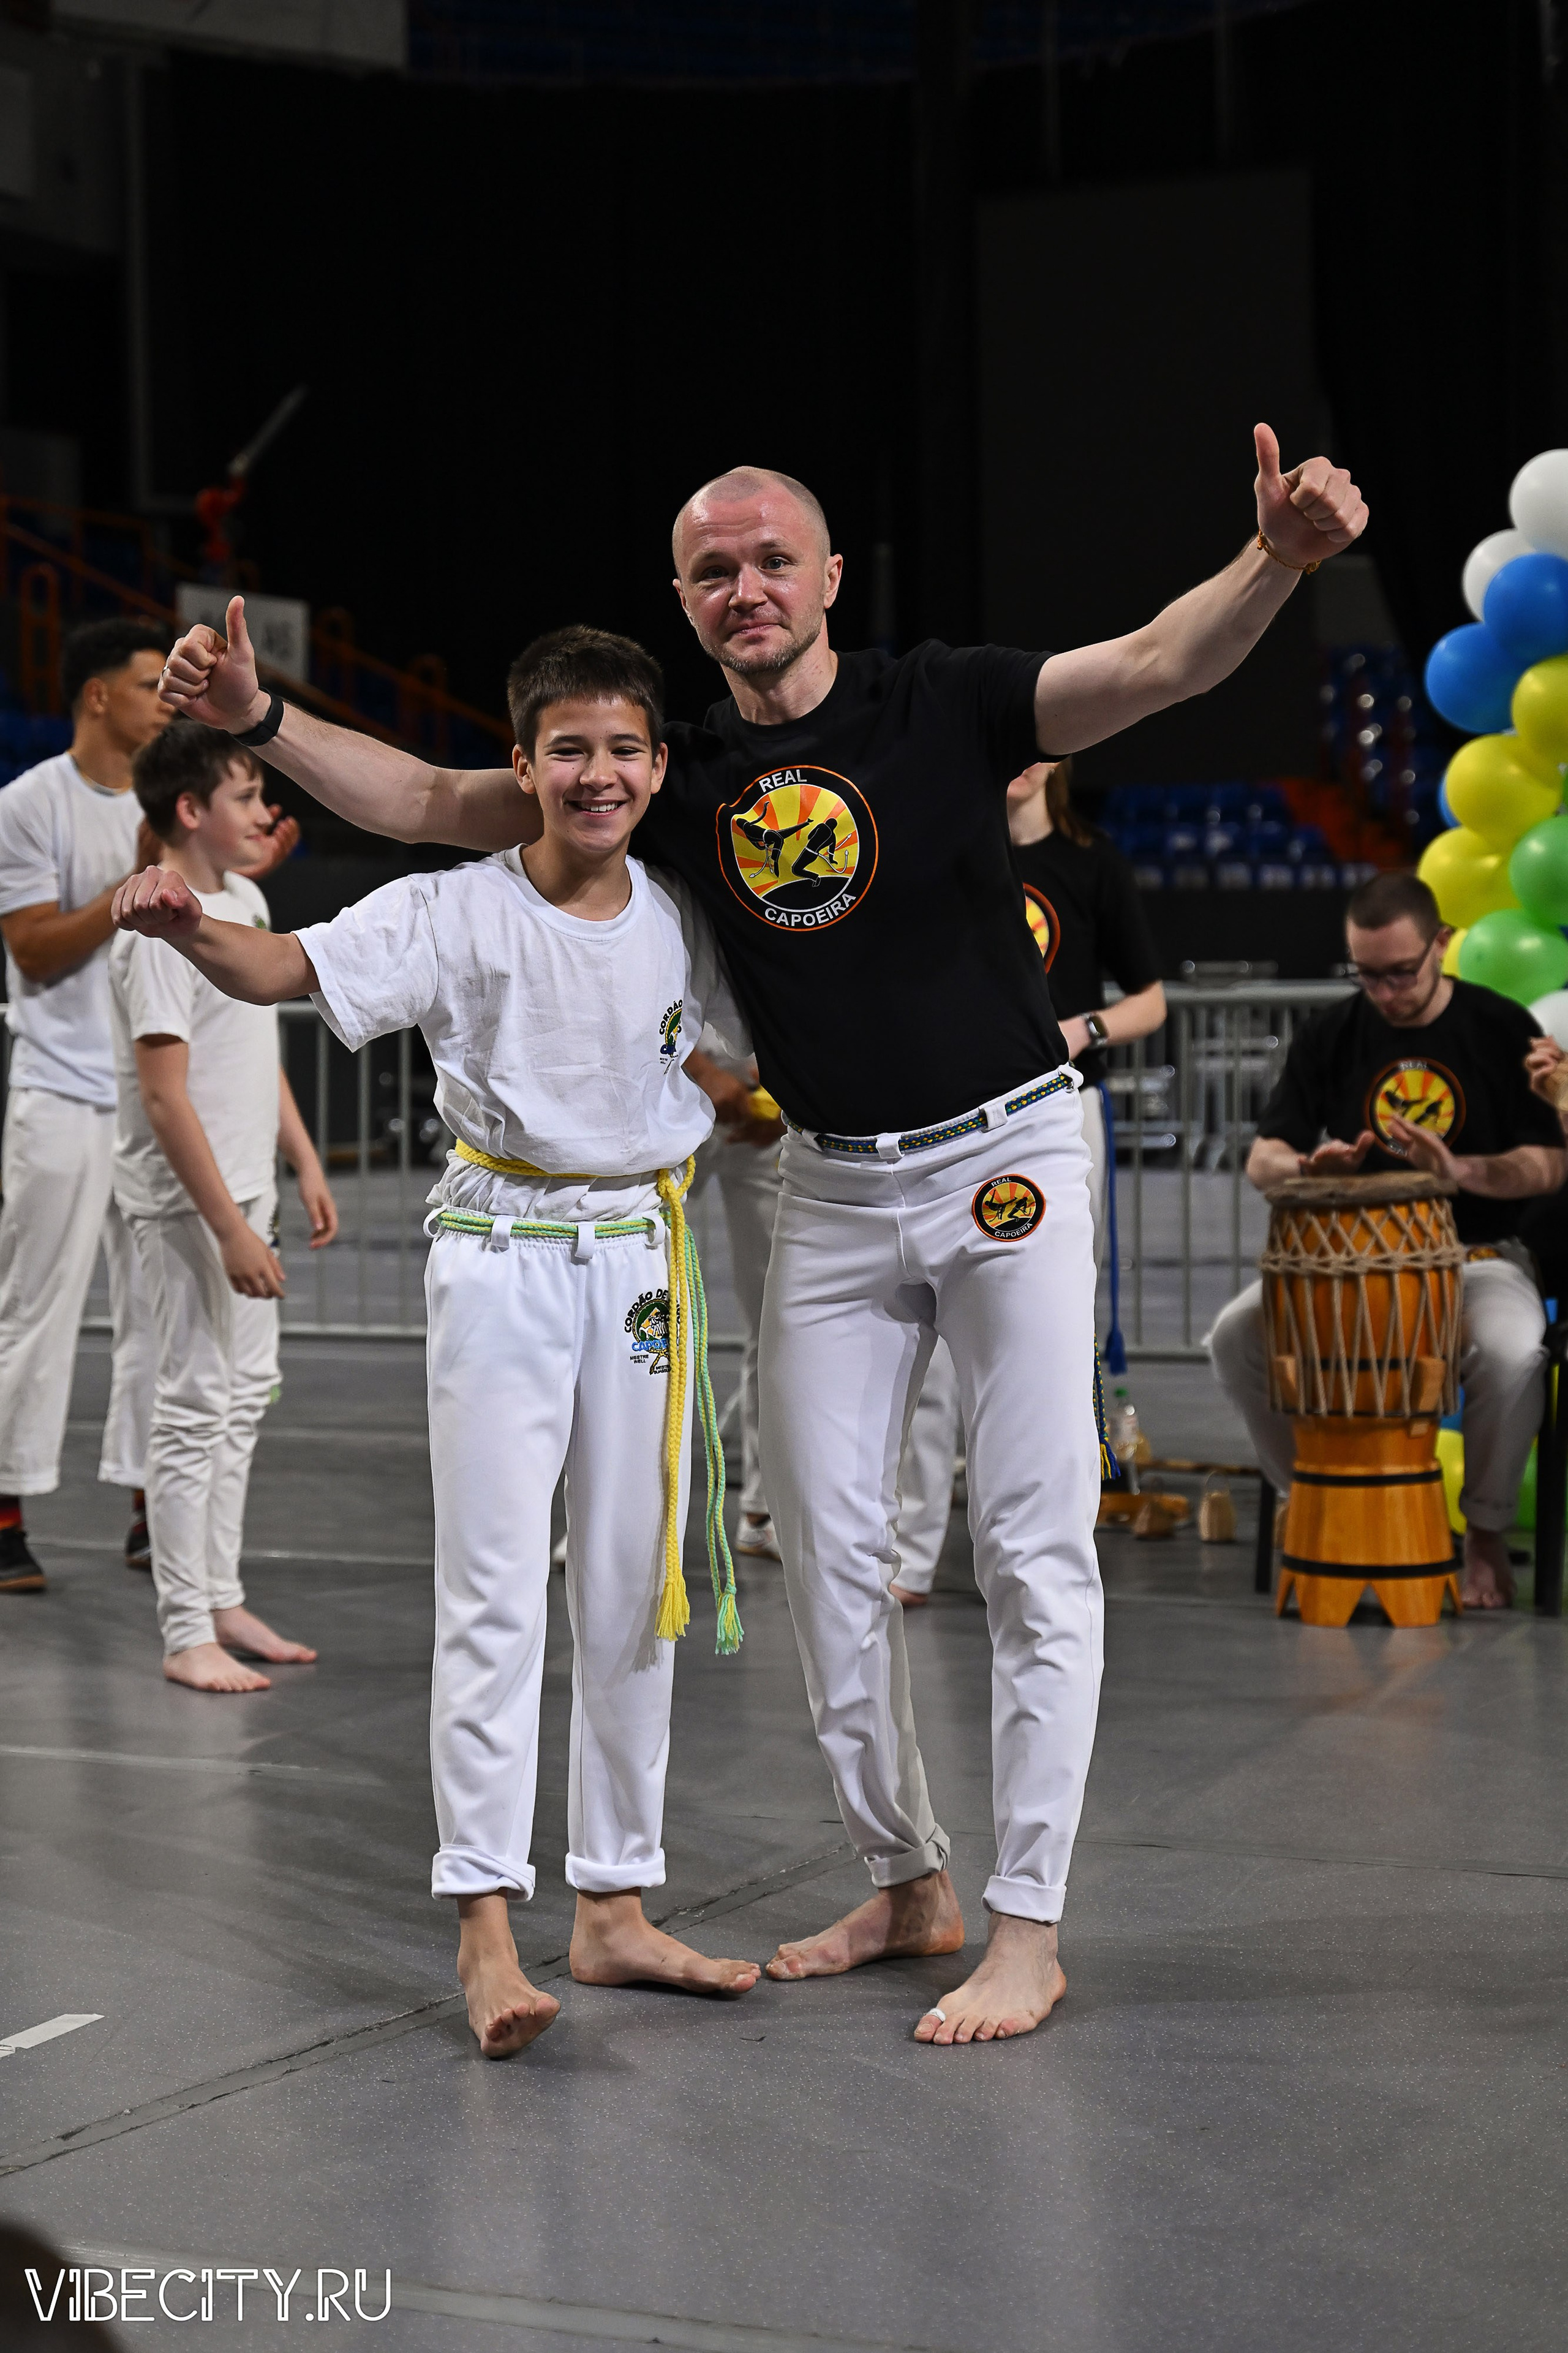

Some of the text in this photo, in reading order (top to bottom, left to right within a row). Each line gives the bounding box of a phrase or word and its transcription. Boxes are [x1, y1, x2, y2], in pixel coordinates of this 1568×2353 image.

[759, 769, 807, 793] REAL
[764, 893, 857, 927] CAPOEIRA
[659, 999, 683, 1035] CORDÃO
[991, 1177, 1012, 1187] REAL
[994, 1223, 1033, 1238] CAPOEIRA
[624, 1291, 653, 1333] CORDÃO
[655, 1288, 669, 1299] DE
[631, 1338, 668, 1351] CAPOE
